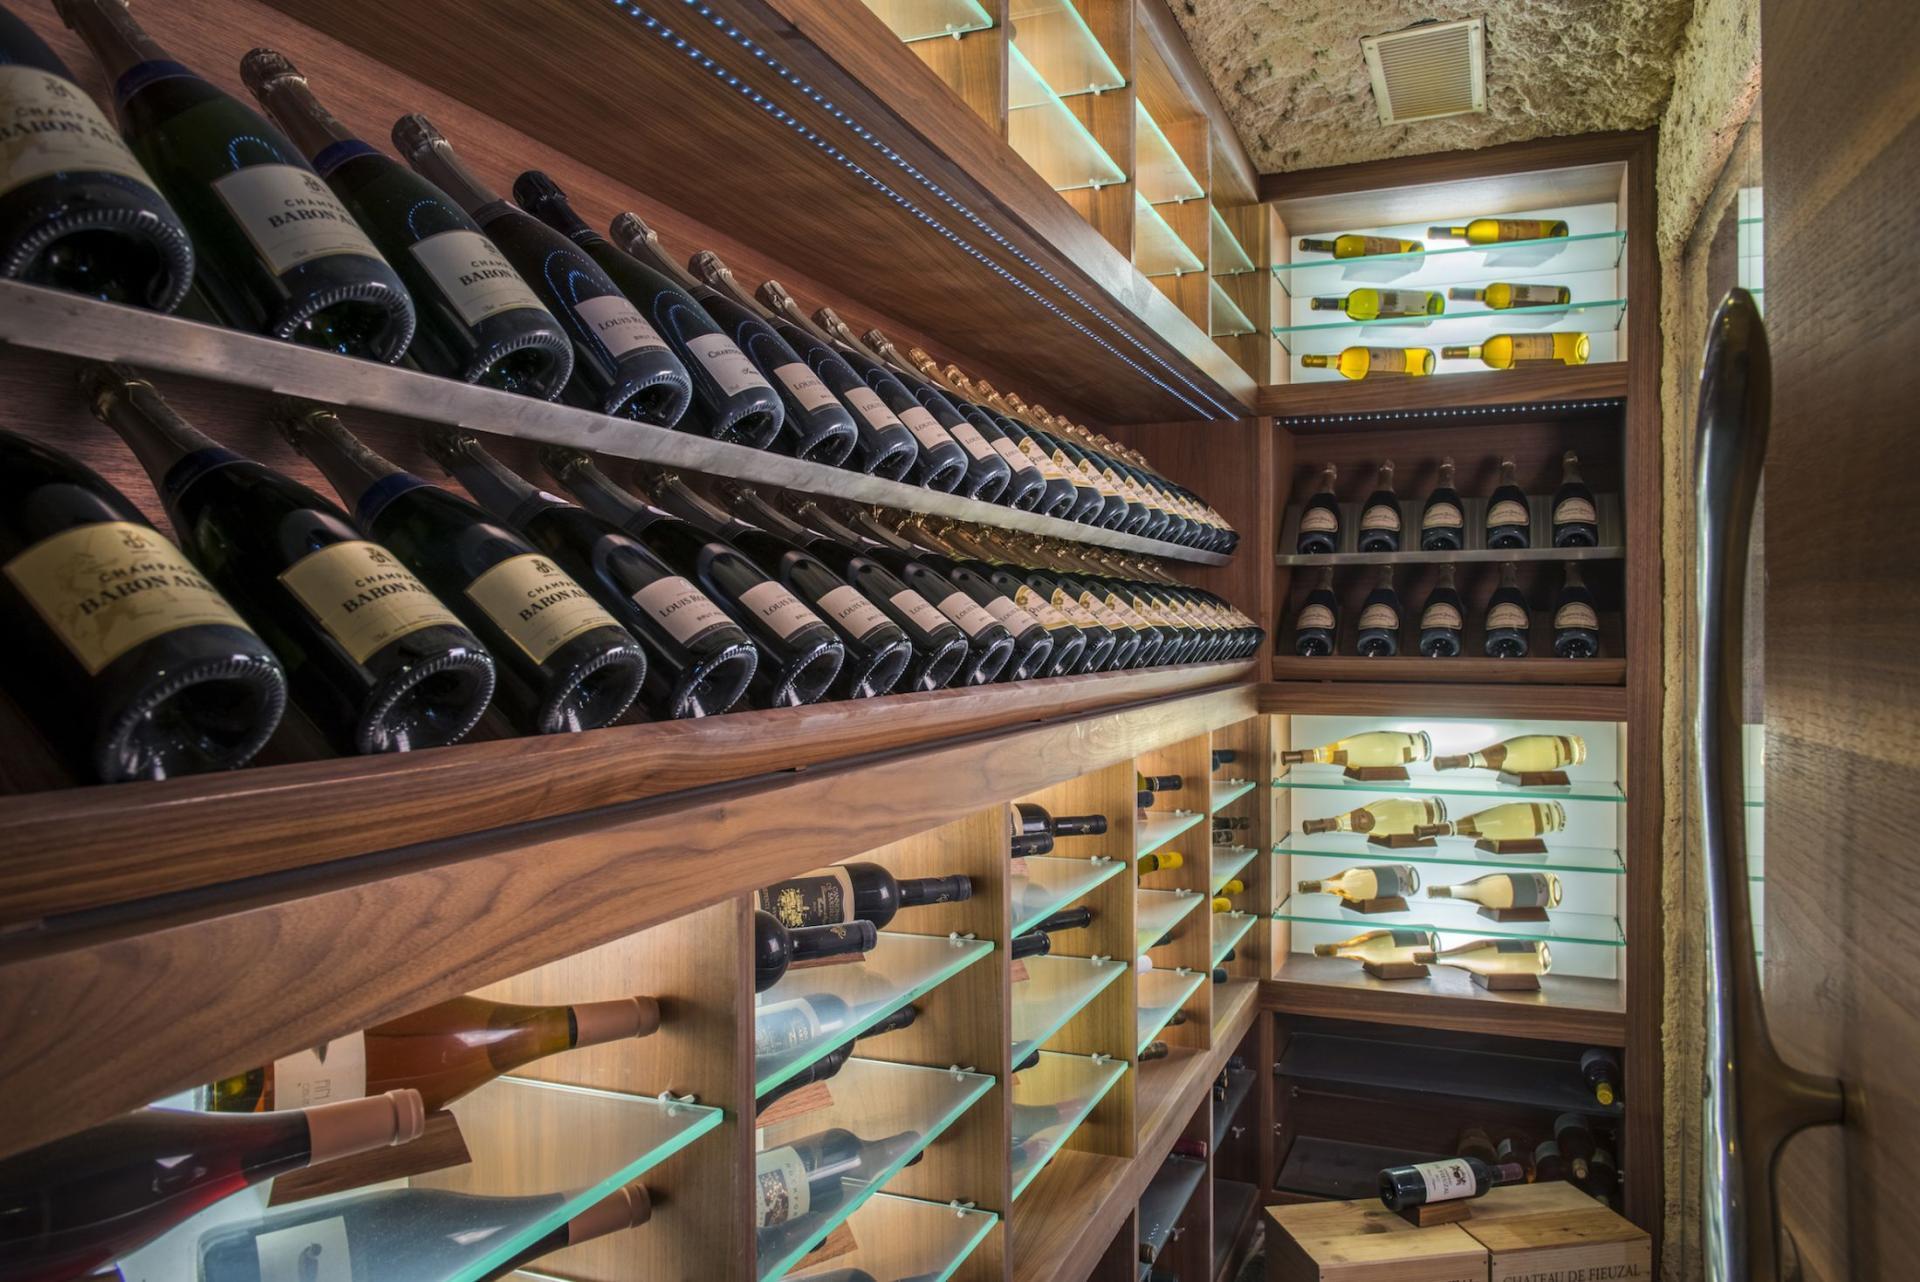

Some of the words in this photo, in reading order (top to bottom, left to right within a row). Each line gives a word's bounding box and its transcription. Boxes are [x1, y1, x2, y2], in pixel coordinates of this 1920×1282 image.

[268, 209, 337, 228] BARON
[459, 269, 512, 286] BARON
[598, 315, 632, 331] LOUIS
[79, 575, 169, 615] BARON
[342, 583, 406, 614] BARON
[518, 590, 571, 622] BARON
[659, 597, 692, 618] LOUIS
[763, 599, 789, 616] LOUIS
[1567, 1267, 1585, 1282] DE
[1588, 1263, 1641, 1281] FIEUZAL
